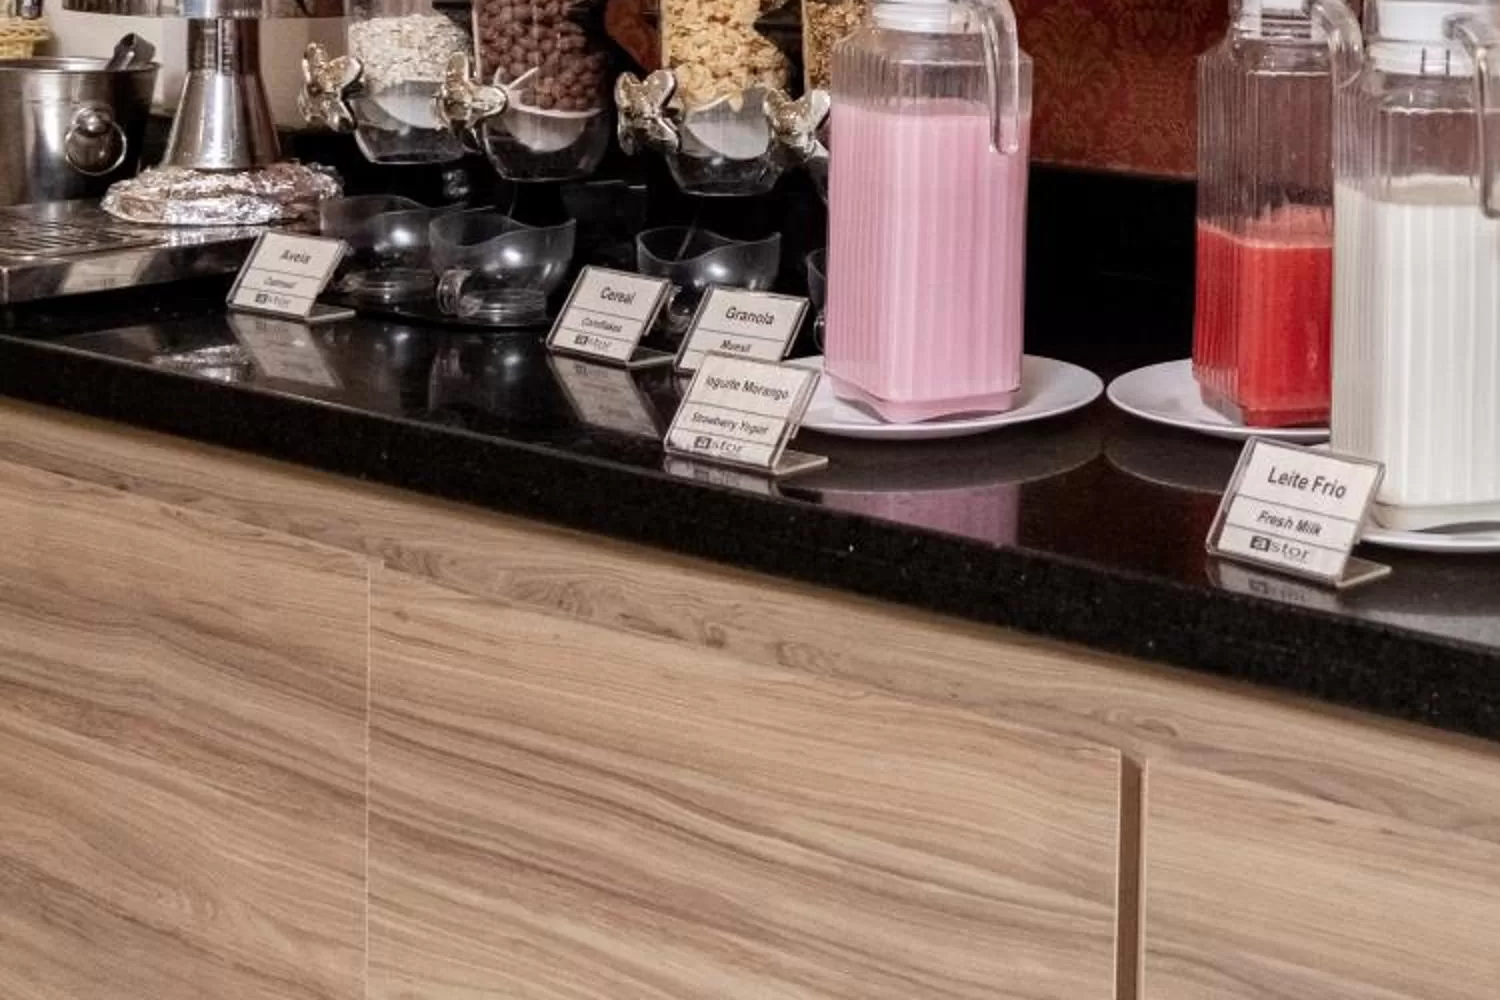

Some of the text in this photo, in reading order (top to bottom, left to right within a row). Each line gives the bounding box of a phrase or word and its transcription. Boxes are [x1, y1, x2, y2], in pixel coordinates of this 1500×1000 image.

[600, 285, 637, 305] Cereal
[725, 306, 775, 325] Granola
[742, 377, 789, 401] Morango
[1267, 465, 1348, 499] Leite Frio
[1256, 509, 1323, 536] Fresh Milk
